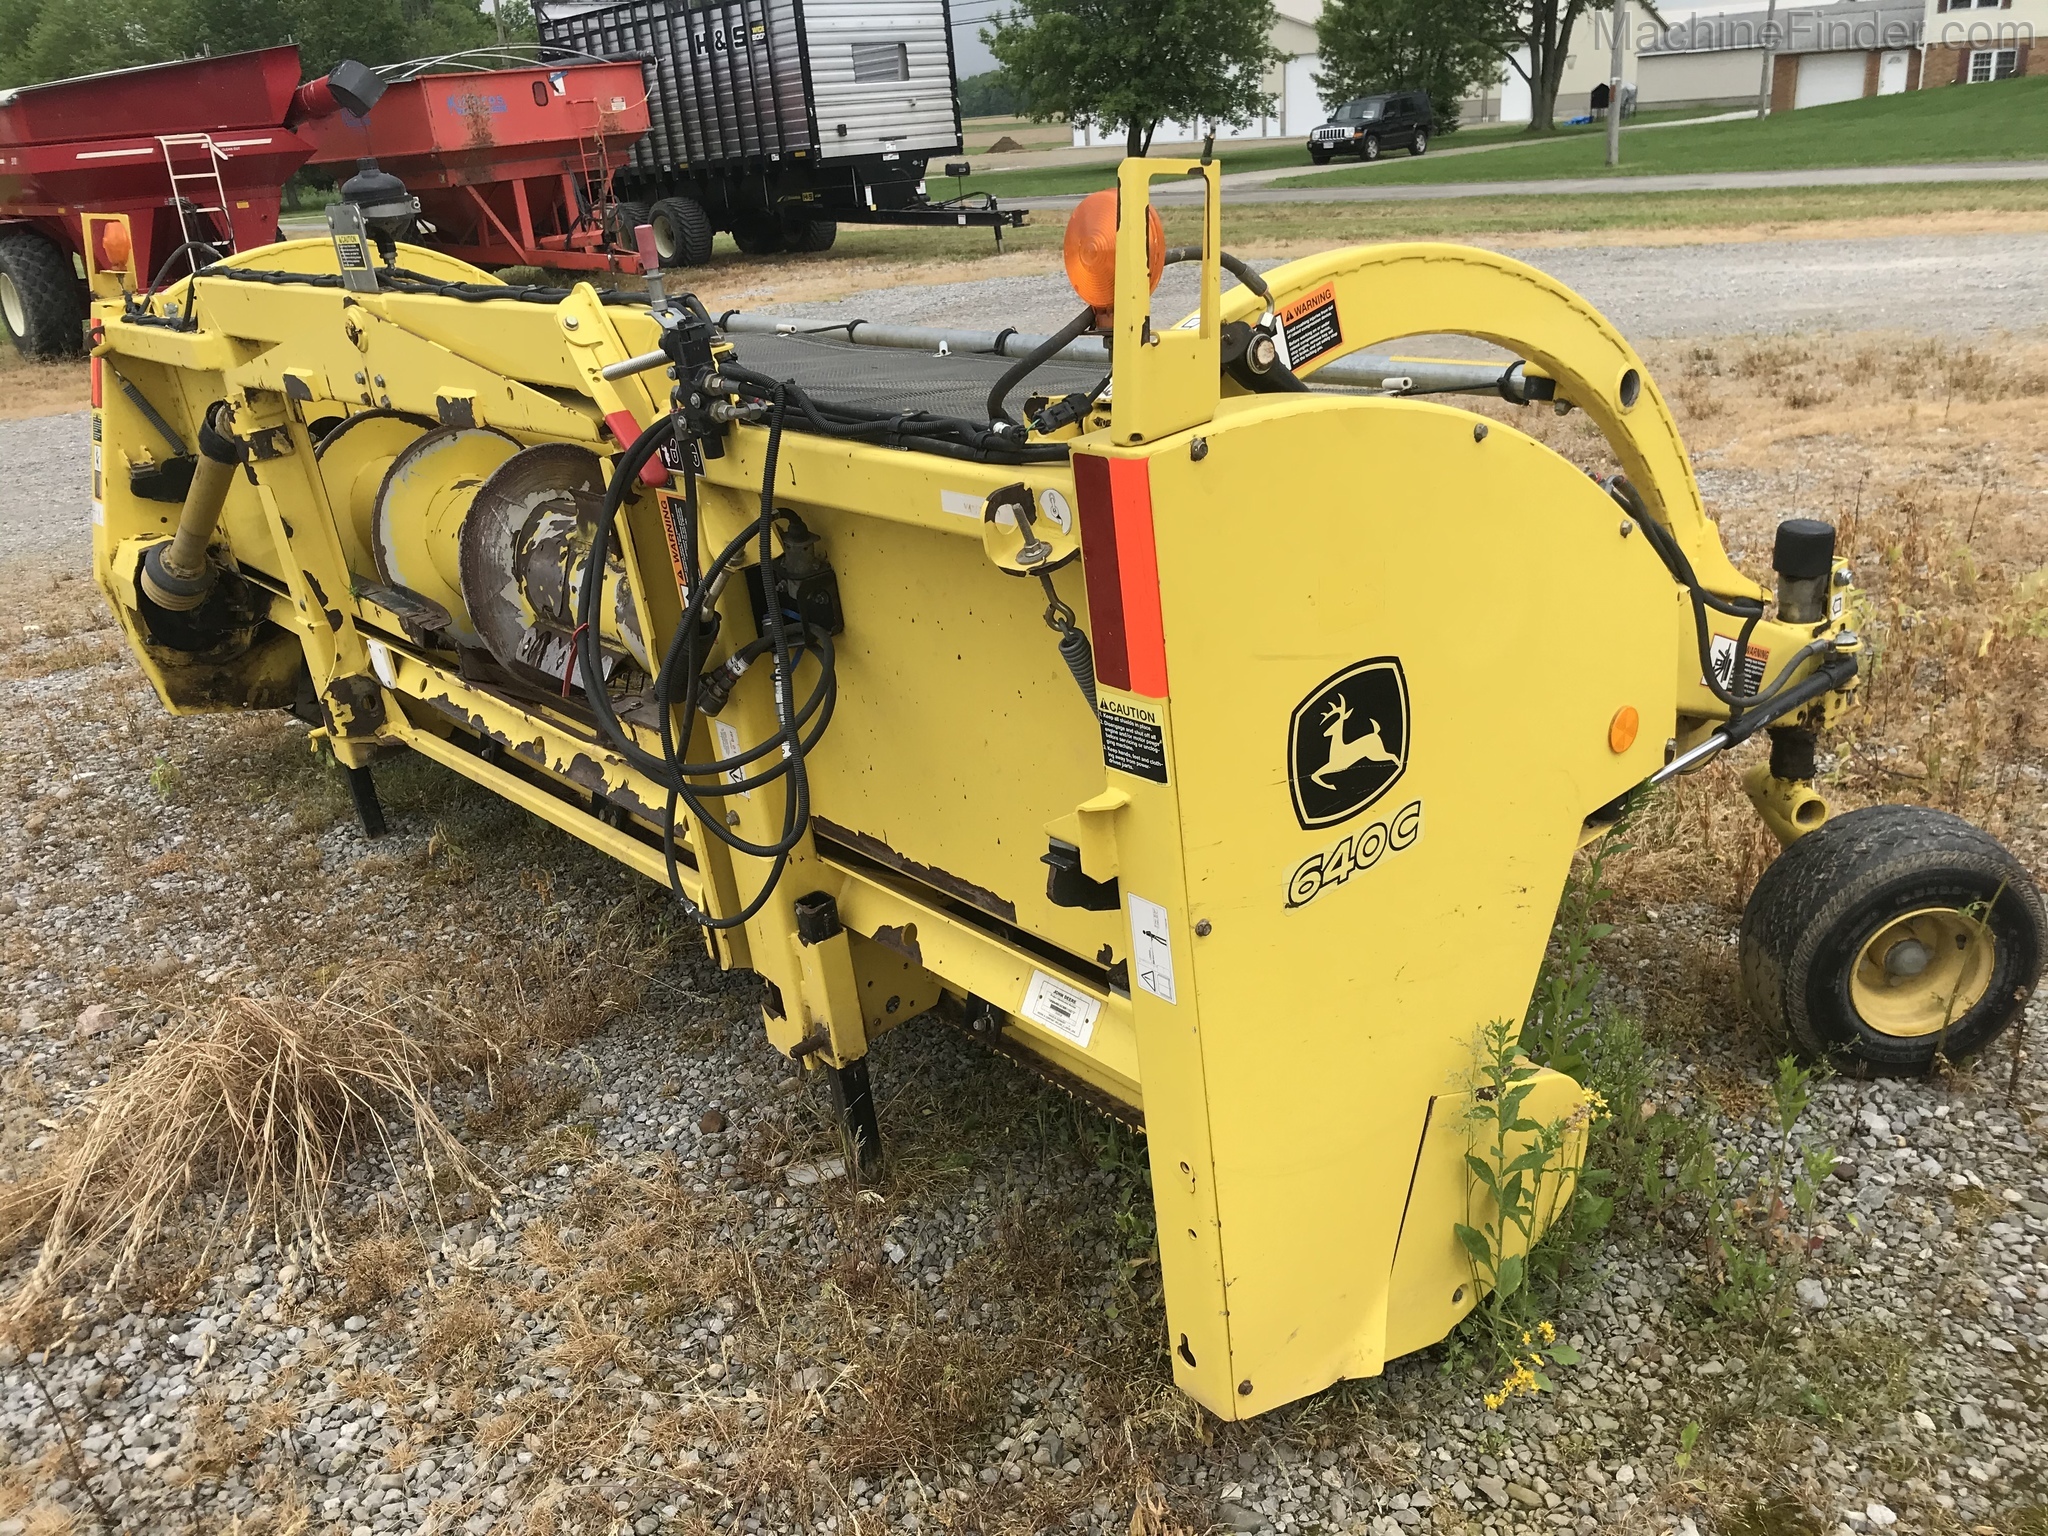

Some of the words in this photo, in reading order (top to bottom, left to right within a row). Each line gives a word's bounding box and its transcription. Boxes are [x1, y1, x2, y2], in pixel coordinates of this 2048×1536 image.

[1294, 289, 1332, 316] WARNING
[660, 500, 680, 562] WARNING
[1109, 701, 1156, 723] CAUTION
[1285, 800, 1421, 907] 640C
[1053, 990, 1064, 998] JOHN
[1064, 994, 1076, 1004] DEERE
